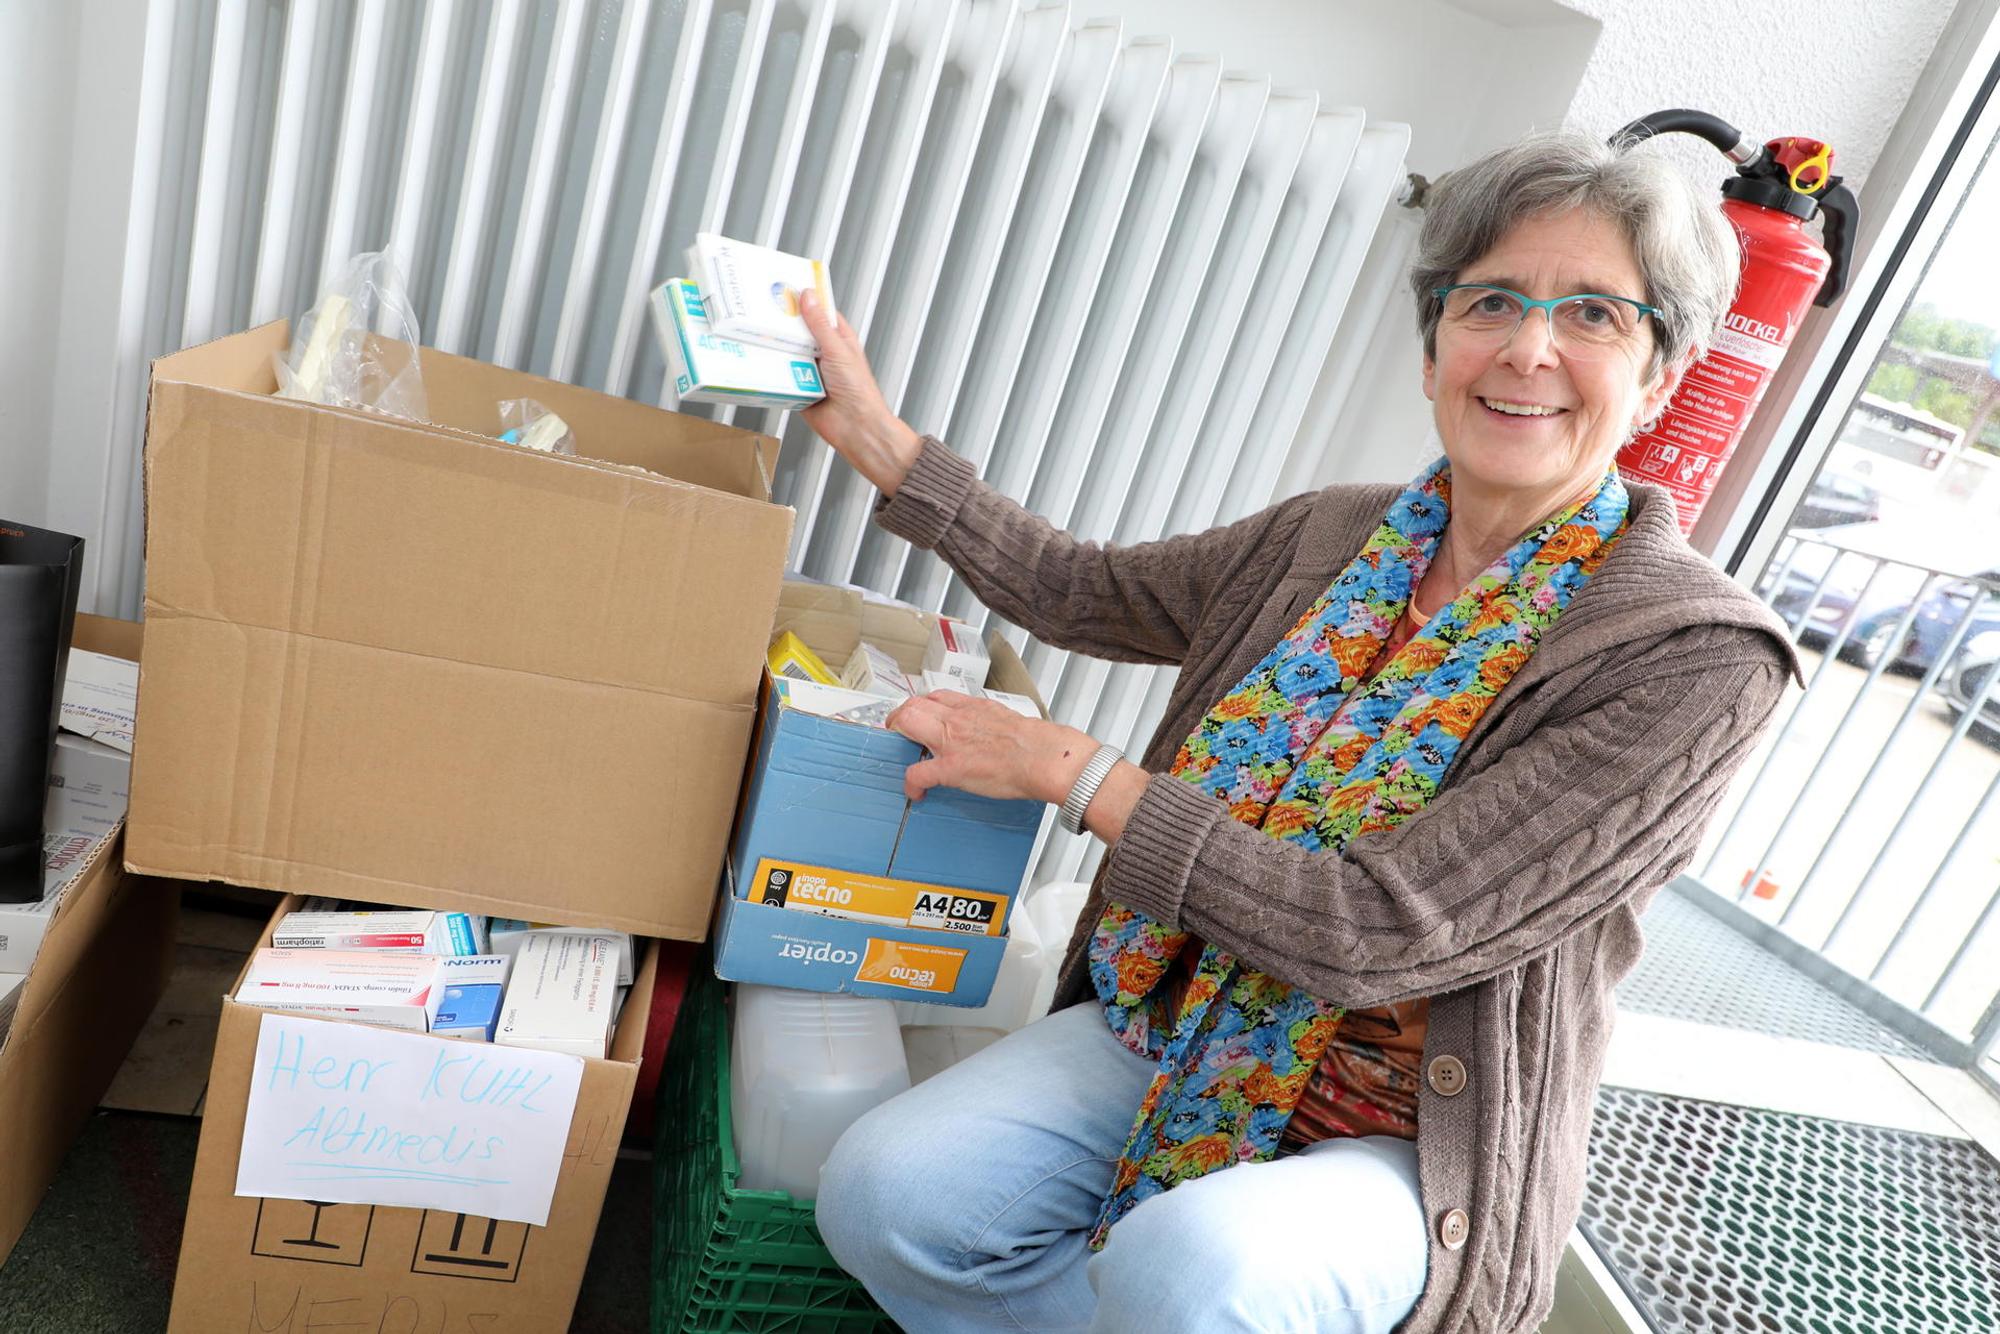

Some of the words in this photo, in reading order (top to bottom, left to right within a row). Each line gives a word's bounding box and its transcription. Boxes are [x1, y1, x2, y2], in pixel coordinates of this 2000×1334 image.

[1723, 312, 1784, 346] JOCKEL
[1666, 449, 1675, 460] A
[792, 875, 853, 905] tecno
[914, 894, 949, 914] A4
[950, 898, 982, 919] 80
[944, 921, 972, 931] 2.500
[276, 938, 325, 946] ratiopharm
[410, 935, 422, 945] 50
[778, 942, 859, 966] copier
[889, 965, 936, 987] tecno
[267, 1030, 396, 1092] Herr
[283, 1105, 506, 1165] Altmedis
